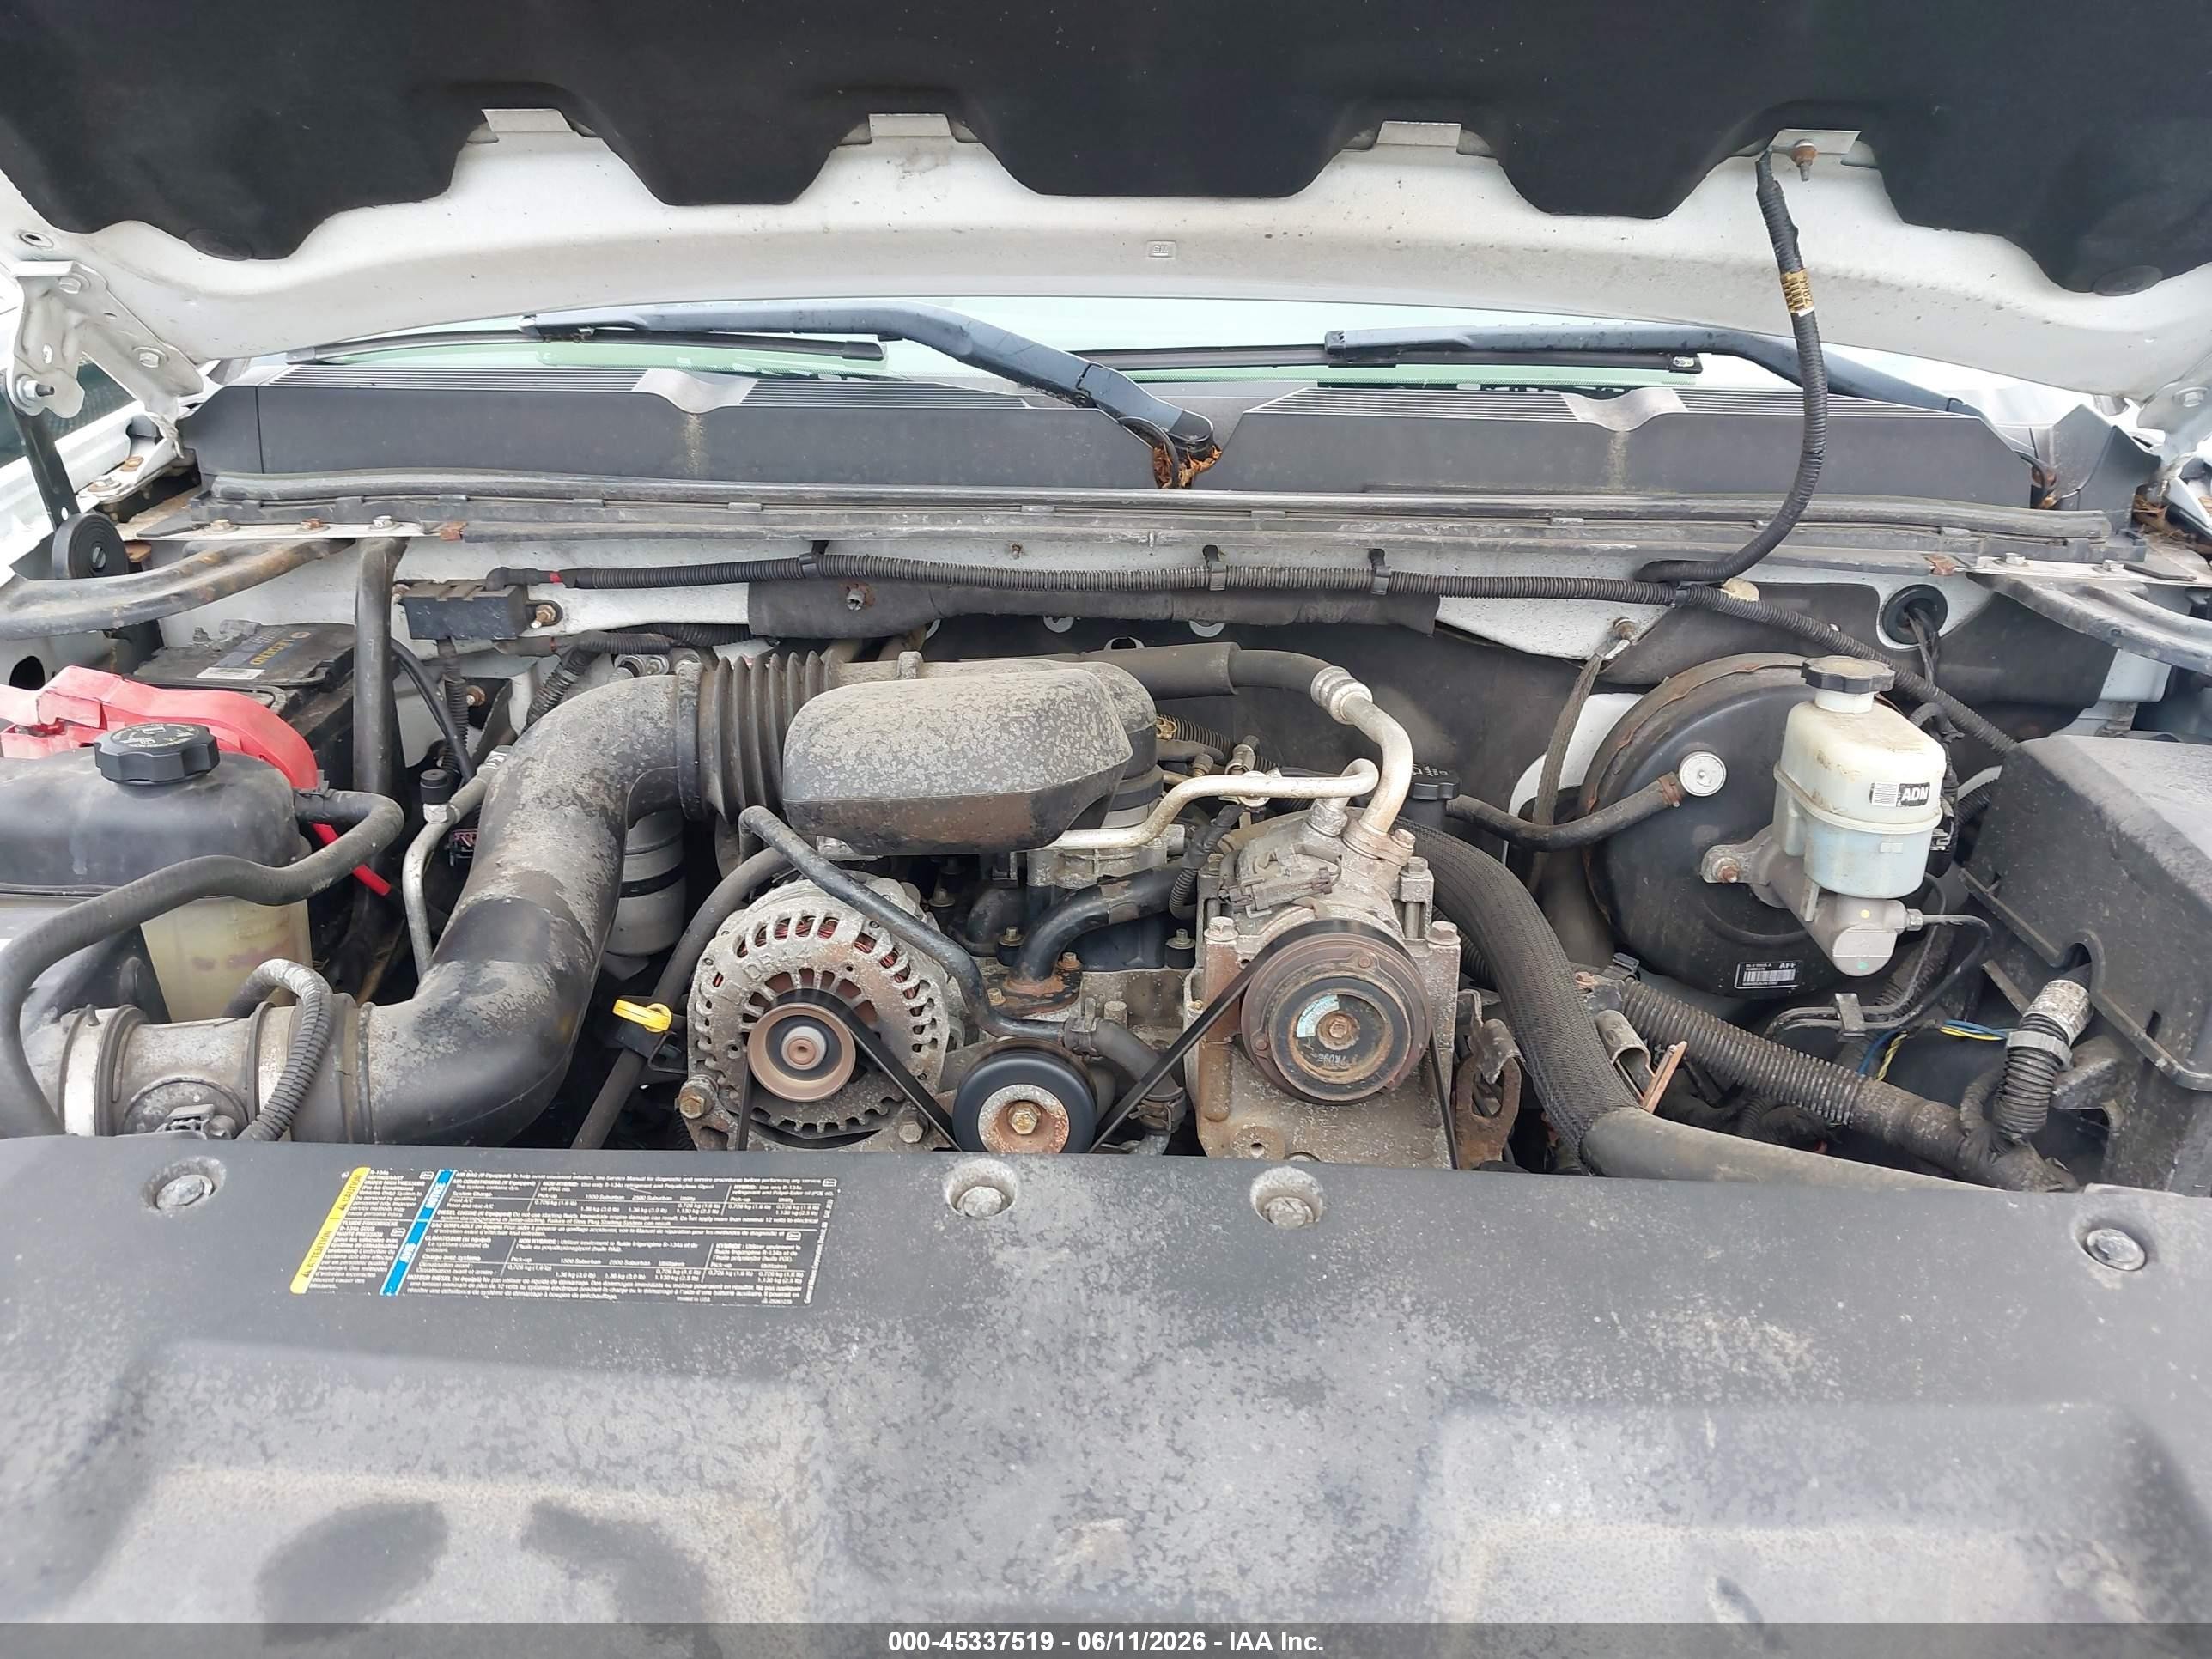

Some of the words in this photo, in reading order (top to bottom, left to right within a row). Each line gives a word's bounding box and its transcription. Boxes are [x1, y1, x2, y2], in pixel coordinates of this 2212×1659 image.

[1901, 786, 1929, 802] ADN
[343, 1174, 364, 1203] CAUTION
[424, 1182, 447, 1208] NOTICE
[307, 1230, 332, 1267] ATTENTION
[399, 1243, 417, 1263] AVIS
